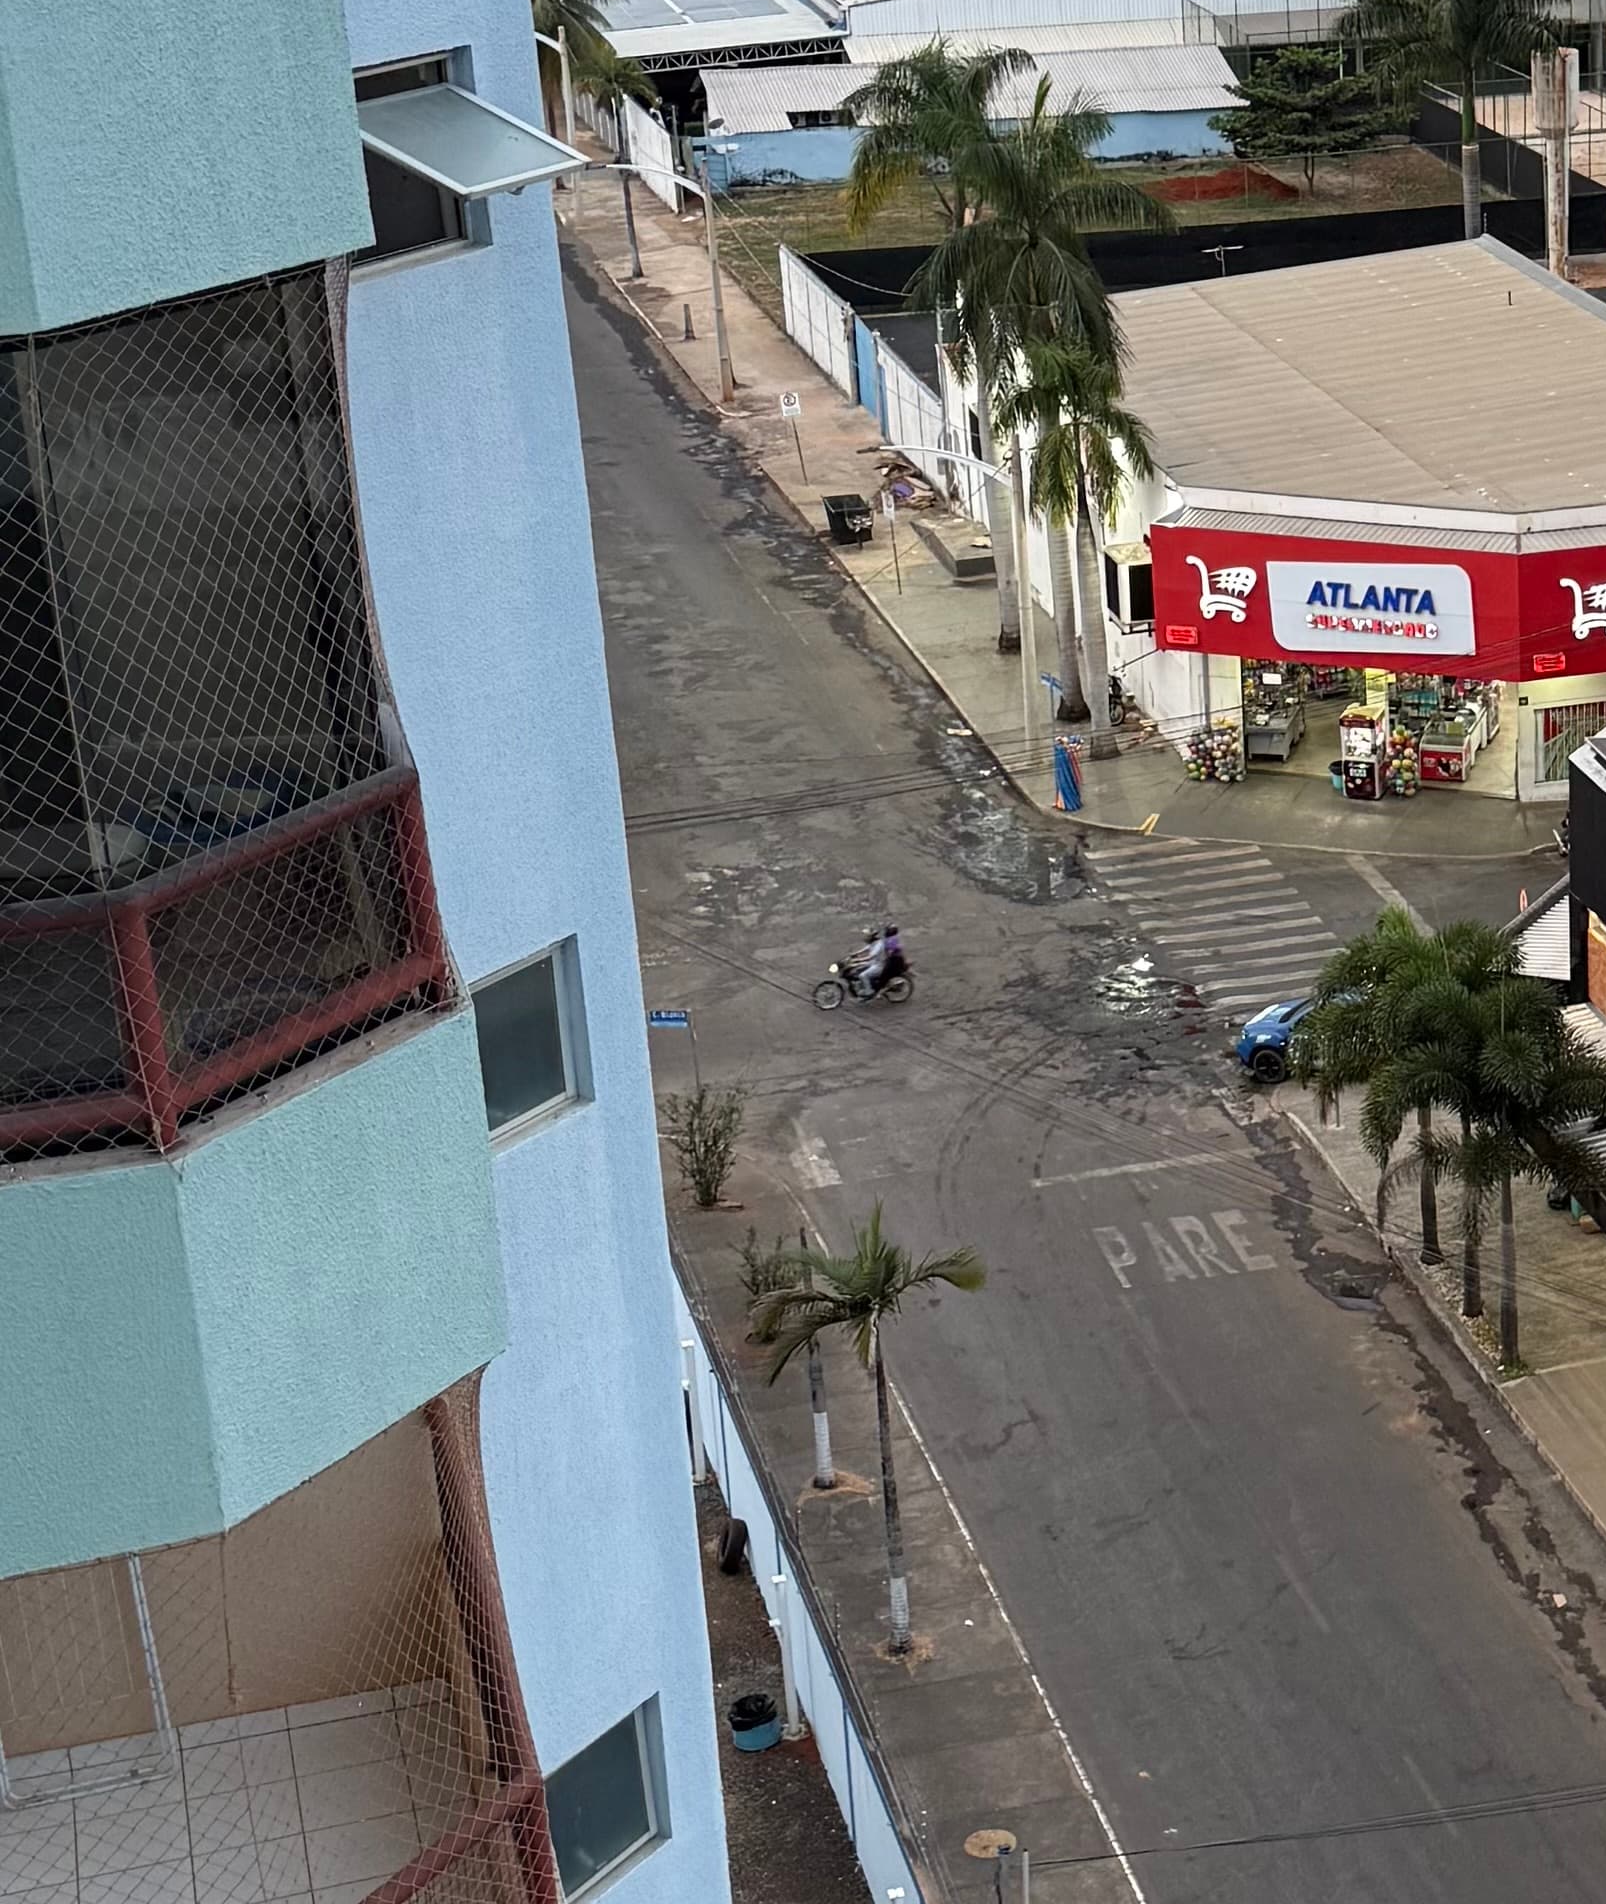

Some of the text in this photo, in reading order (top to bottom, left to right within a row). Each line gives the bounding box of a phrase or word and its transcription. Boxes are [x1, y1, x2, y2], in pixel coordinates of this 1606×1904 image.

[1305, 579, 1437, 616] ATLANTA
[1305, 613, 1439, 639] SUPERMERCADO
[1092, 1208, 1278, 1288] PARE
